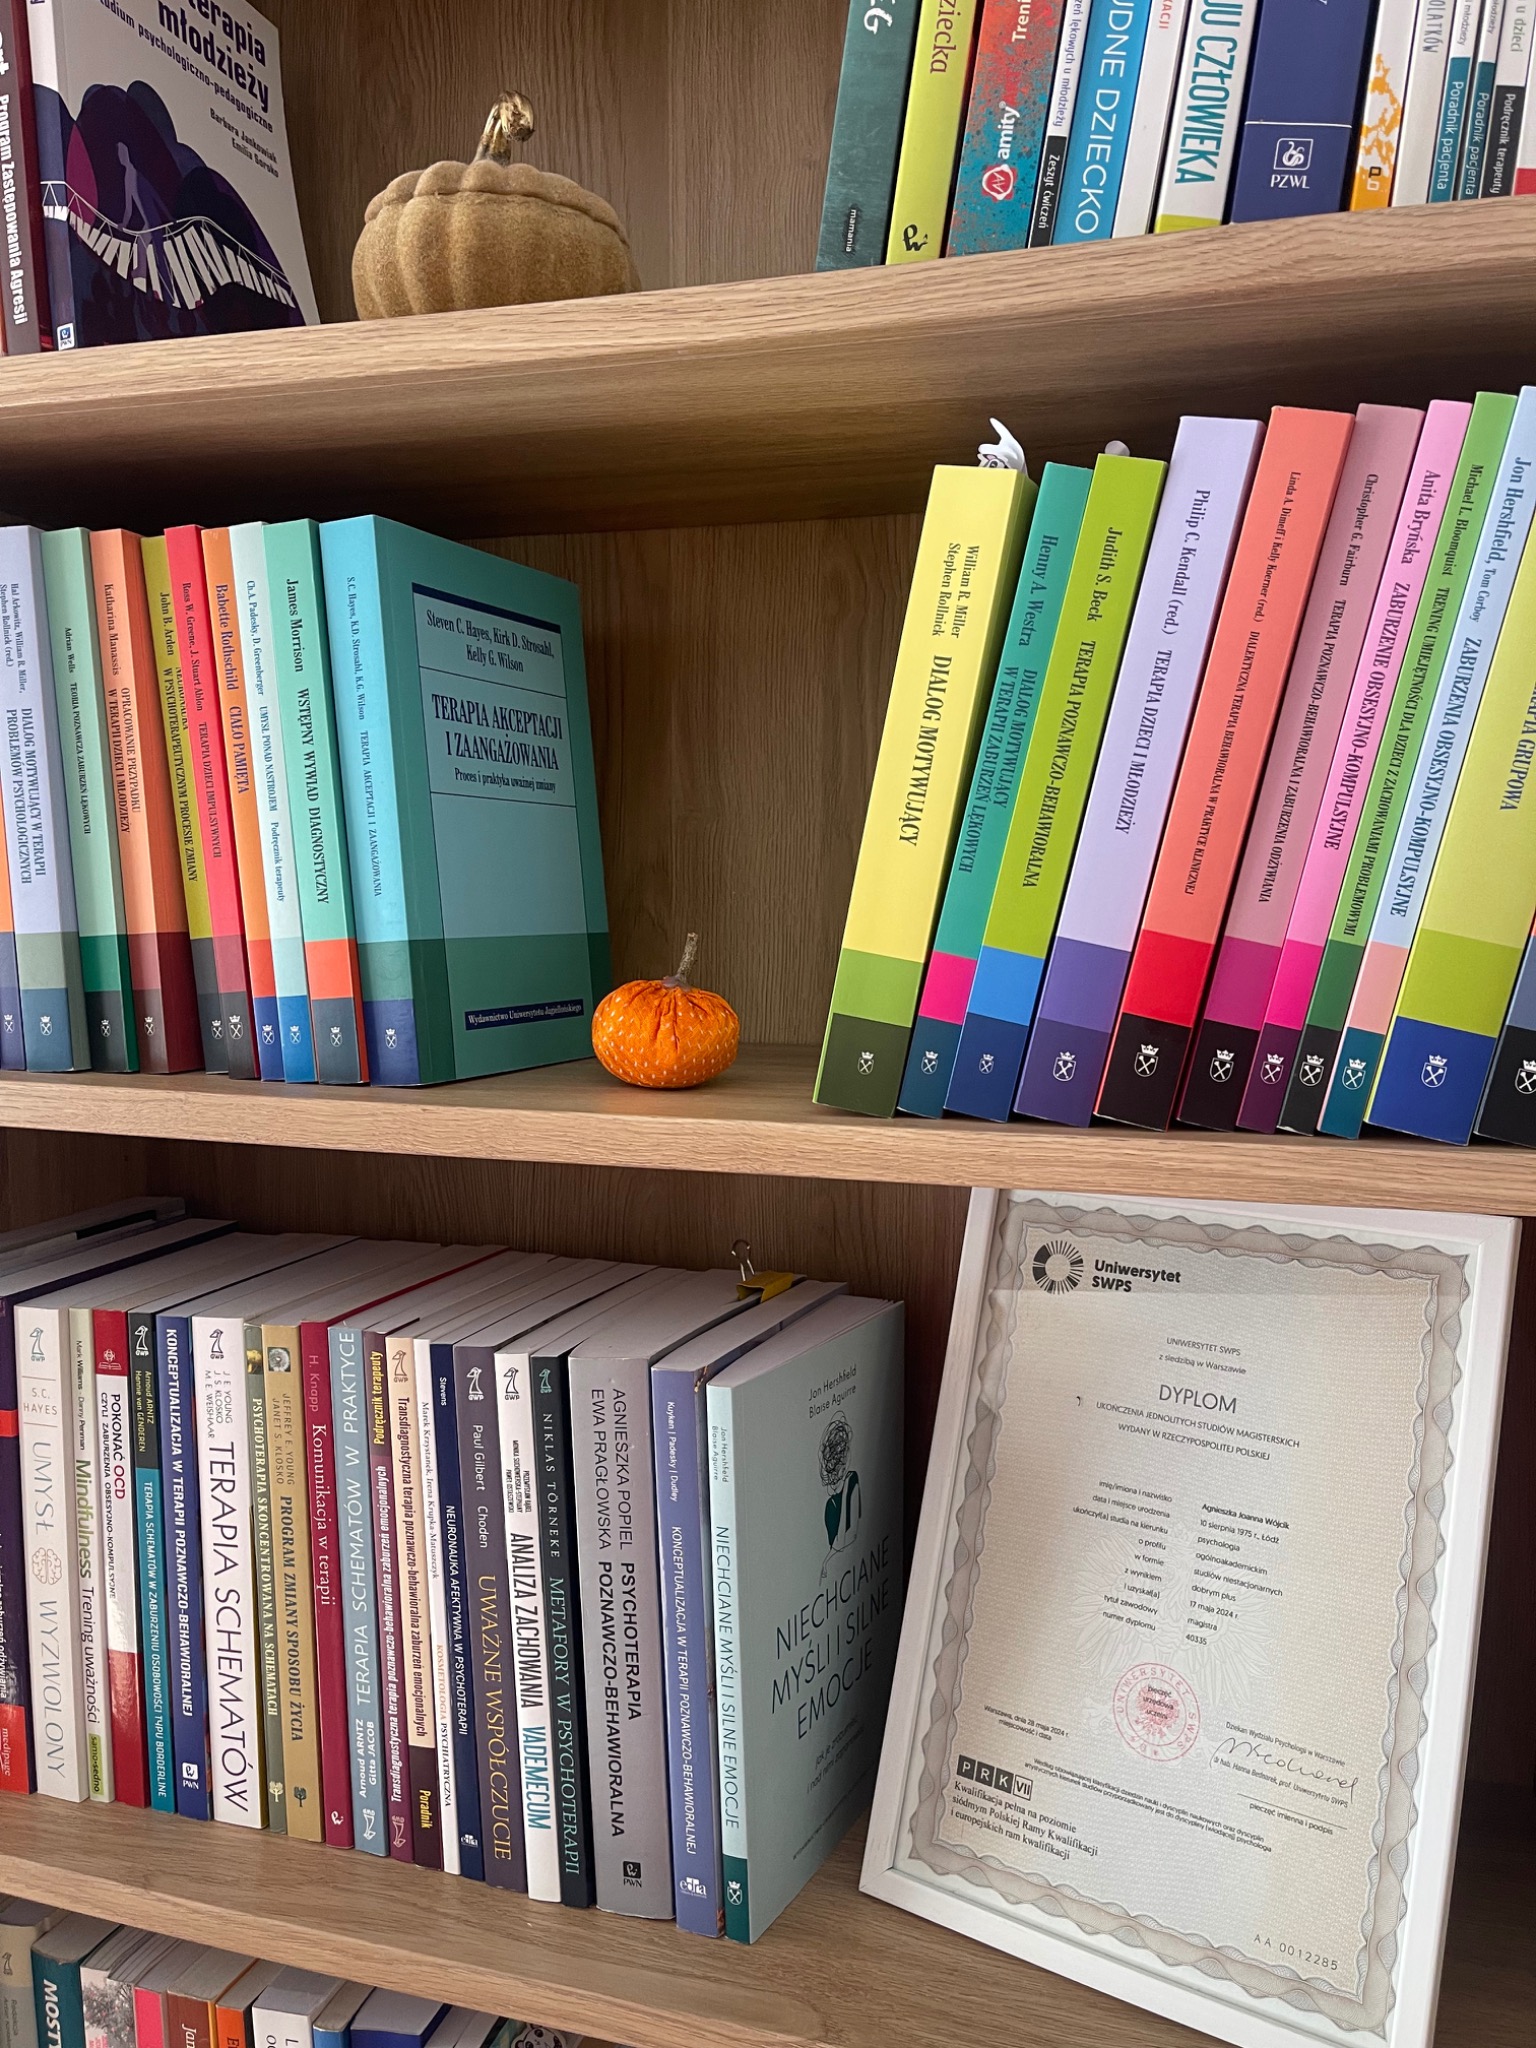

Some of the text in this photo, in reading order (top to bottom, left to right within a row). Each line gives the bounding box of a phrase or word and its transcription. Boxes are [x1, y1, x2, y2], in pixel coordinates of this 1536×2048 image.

[138, 23, 273, 133] psychologiczno-pedagogiczne
[158, 0, 269, 113] młodzieży
[997, 103, 1020, 159] amity
[1175, 35, 1239, 184] CZŁOWIEKA
[1436, 80, 1464, 190] Poradnik pacjenta
[1465, 91, 1491, 196] Poradnik pacjenta
[1489, 92, 1516, 194] Podręcznik terapeuty
[1043, 154, 1061, 187] Zeszyt
[1075, 89, 1120, 234] DZIECKO
[1270, 174, 1310, 189] PZWL
[0, 163, 28, 325] Zastępowania Agresji
[845, 208, 857, 253] mamania
[1184, 530, 1200, 544] C.
[1185, 489, 1211, 529] Philip
[104, 583, 115, 631] Katharina
[951, 544, 980, 639] William R. Miller
[1018, 534, 1059, 647] Henny A. Westra
[1161, 599, 1184, 636] (red.)
[1171, 546, 1197, 597] Kendall
[109, 633, 119, 676] Manassis
[426, 609, 454, 631] Steven
[457, 618, 465, 634] C.
[466, 620, 492, 644] Hayes,
[493, 627, 511, 647] Kirk
[511, 633, 521, 649] D.
[466, 644, 524, 673] Kelly G. Wilson
[1323, 469, 1441, 851] Anita Bryńska ZABURZENIE OBSESYJNO-KOMPULSYJNE
[215, 584, 250, 794] Babette Rothschild CIAŁO PAMIĘTA
[431, 693, 563, 740] TERAPIA AKCEPTACJI
[898, 542, 961, 847] Stephen Rollnick DIALOG MOTYWUJĄCY
[1022, 526, 1123, 888] Judith S. Beck TERAPIA POZNAWCZO-BEHAWIORALNA
[1145, 649, 1173, 705] TERAPIA
[1390, 456, 1532, 918] Jon Hershfield, Tom Corboy ZABURZENIA OBSESYJNO-KOMPULSYJNE
[286, 578, 329, 904] James Morrison WSTĘPNY WYWIAD DIAGNOSTYCZNY
[445, 731, 560, 771] I ZAANGAŻOWANIA
[958, 666, 1019, 873] W TERAPII ZABURZEŃ LĘKOWYCH
[993, 669, 1038, 809] DIALOG MOTYWUJĄCY
[1135, 705, 1159, 751] DZIECI
[1499, 738, 1535, 812] GRUPOWA
[1115, 759, 1146, 835] MŁODZIEŻY
[1091, 1275, 1132, 1293] SWPS
[1094, 1258, 1181, 1284] Uniwersytet
[1166, 1336, 1241, 1356] UNIWERSYTET SWPS
[22, 1402, 58, 1416] HAYES
[31, 1388, 50, 1400] S.C.
[369, 1350, 387, 1446] Podręcznik terapeuty
[1096, 1401, 1300, 1448] UKOŃCZENIA JEDNOLITYCH STUDIÓW MAGISTERSKICH
[1158, 1384, 1238, 1414] DYPLOM
[110, 1393, 126, 1500] POKONAĆ OCD
[305, 1354, 336, 1606] H. Knapp Komunikacja w terapii
[166, 1328, 193, 1717] KONCEPTUALIZACJA W TERAPII POZNAWCZO-BEHAWIORALNEJ
[338, 1332, 371, 1706] TERAPIA SCHEMATÓW W PRAKTYCE
[510, 1532, 537, 1599] ANALIZA
[612, 1388, 642, 1720] AGNIESZKA POPIEL PSYCHOTERAPIA
[32, 1441, 66, 1779] UMYSŁ WYZWOLONY
[74, 1459, 101, 1724] Mindfulness Trening uważności
[209, 1441, 254, 1812] TERAPIA SCHEMATÓW
[279, 1495, 306, 1742] PROGRAM ZMIANY SPOSOBU ŻYCIA
[591, 1389, 625, 1837] EWA PRAGŁOWSKA POZNAWCZO-BEHAWIORALNA
[715, 1525, 734, 1635] NIECHCIANE
[775, 1534, 891, 1660] NIECHCIANE
[472, 1424, 512, 1861] Paul Gilbert Choden UWAŻNE WSPÓŁCZUCIE
[515, 1605, 544, 1709] ZACHOWANIA
[543, 1413, 580, 1875] NIKLAS TÖRNEKE METAFORY W PSYCHOTERAPII
[720, 1638, 739, 1689] MYŚLI
[771, 1637, 831, 1714] MYŚLI
[845, 1575, 891, 1649] SILNE
[796, 1637, 874, 1740] EMOCJE
[722, 1703, 737, 1751] SILNE
[419, 1789, 433, 1829] Poradnik
[522, 1725, 552, 1830] VADEMECUM
[723, 1753, 740, 1829] EMOCJE
[954, 1781, 1003, 1807] Kwalifikacja
[1004, 1798, 1027, 1815] pełna
[1038, 1813, 1077, 1833] poziomie
[952, 1795, 1099, 1856] siódmym Polskiej Ramy Kwalifikacji
[955, 1810, 1070, 1859] europejskich ram kwalifikacji
[623, 1878, 642, 1887] PWN
[1279, 1942, 1338, 1970] 0012285
